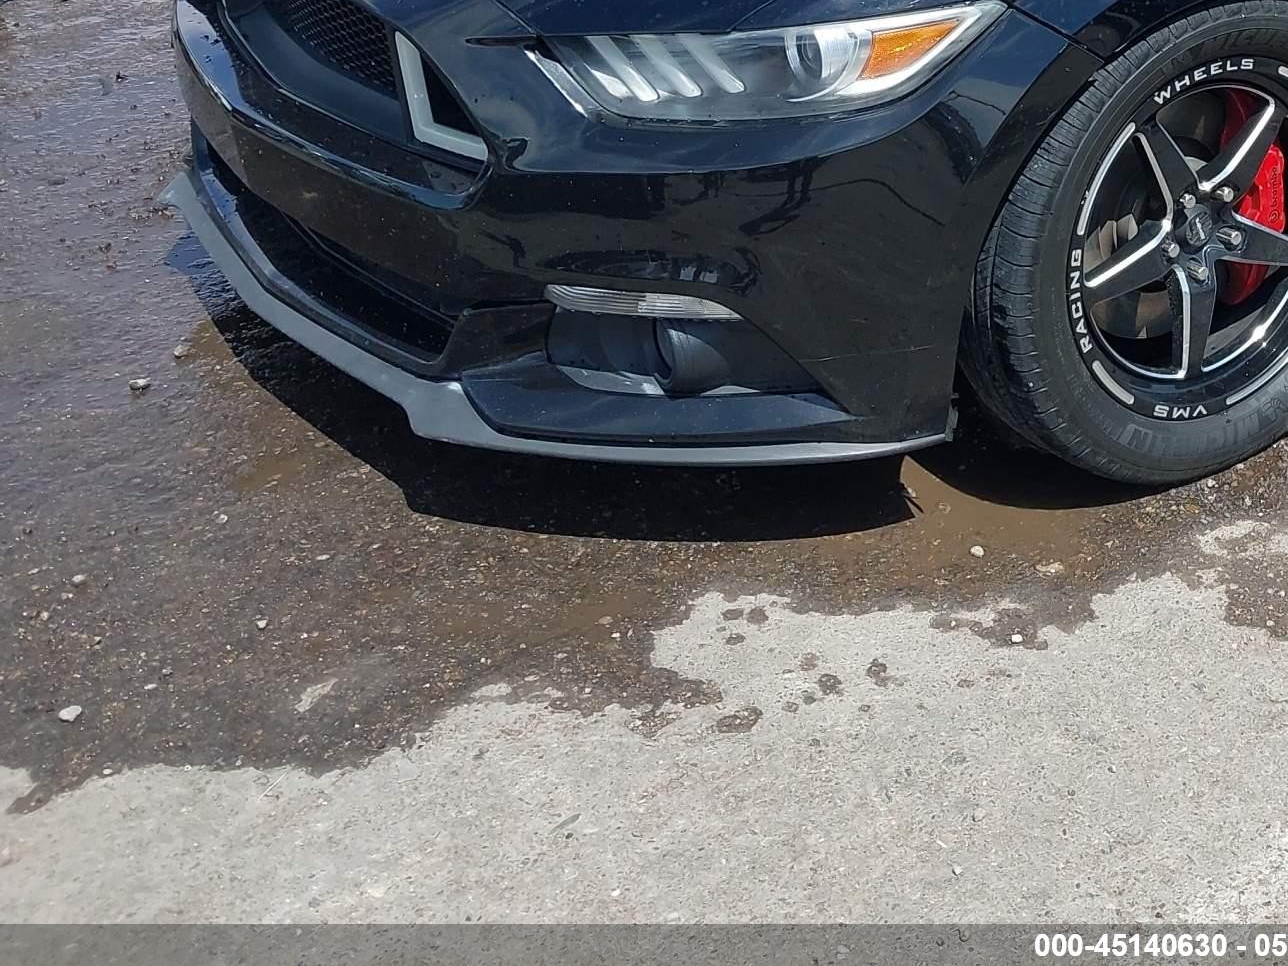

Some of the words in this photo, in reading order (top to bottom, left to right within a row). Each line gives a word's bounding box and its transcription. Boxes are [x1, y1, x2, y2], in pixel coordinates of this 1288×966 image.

[1153, 58, 1255, 105] WHEELS
[1270, 166, 1279, 208] brembo
[1068, 248, 1093, 353] RACING
[1153, 403, 1208, 419] VMS
